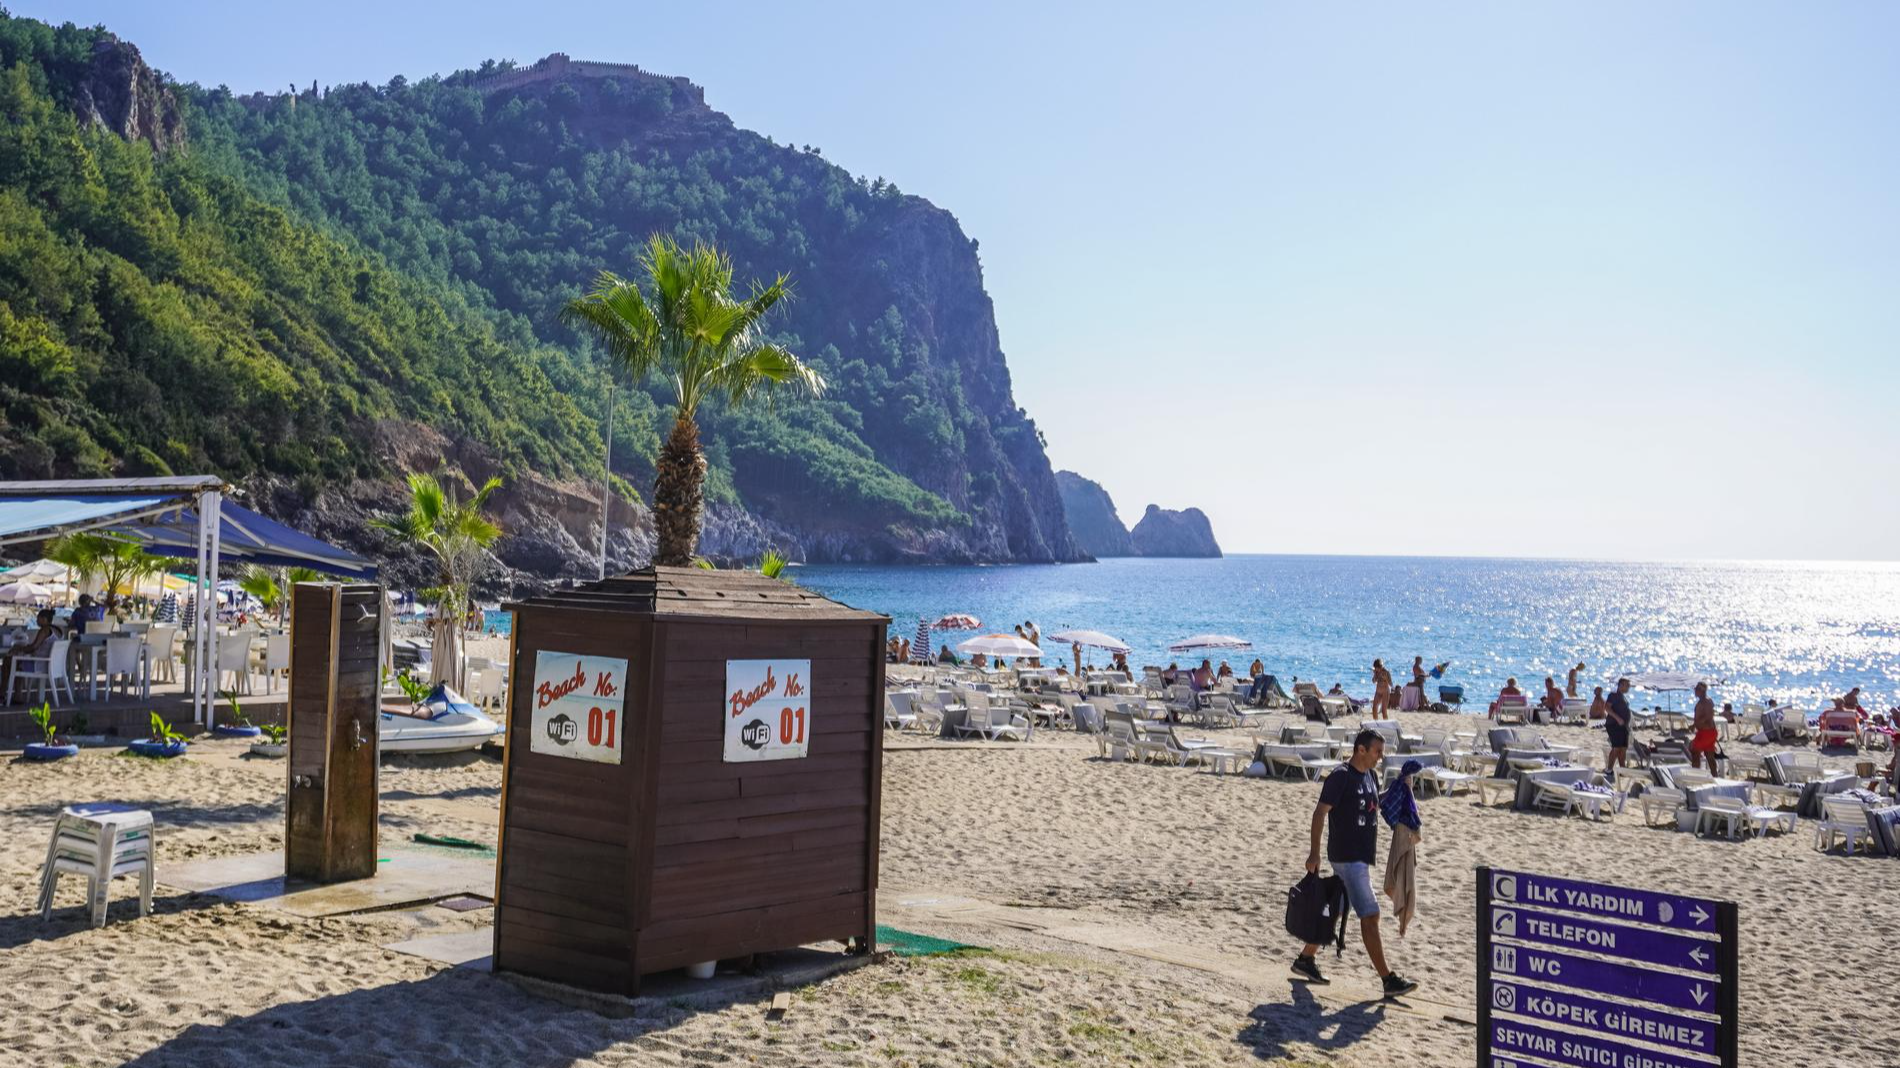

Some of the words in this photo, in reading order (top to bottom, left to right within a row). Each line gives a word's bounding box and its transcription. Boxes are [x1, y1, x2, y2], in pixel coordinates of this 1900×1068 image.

[536, 660, 586, 710] Beach
[729, 665, 777, 719] Beach
[587, 706, 616, 749] 01
[780, 706, 805, 745] 01
[1526, 880, 1559, 903] İLK
[1564, 890, 1644, 917] YARDIM
[1526, 919, 1616, 948] TELEFON
[1528, 956, 1561, 976] WC
[1526, 996, 1599, 1026] KÖPEK
[1604, 1012, 1705, 1047] GİREMEZ
[1496, 1027, 1557, 1054] SEYYAR
[1561, 1041, 1618, 1068] SATICI
